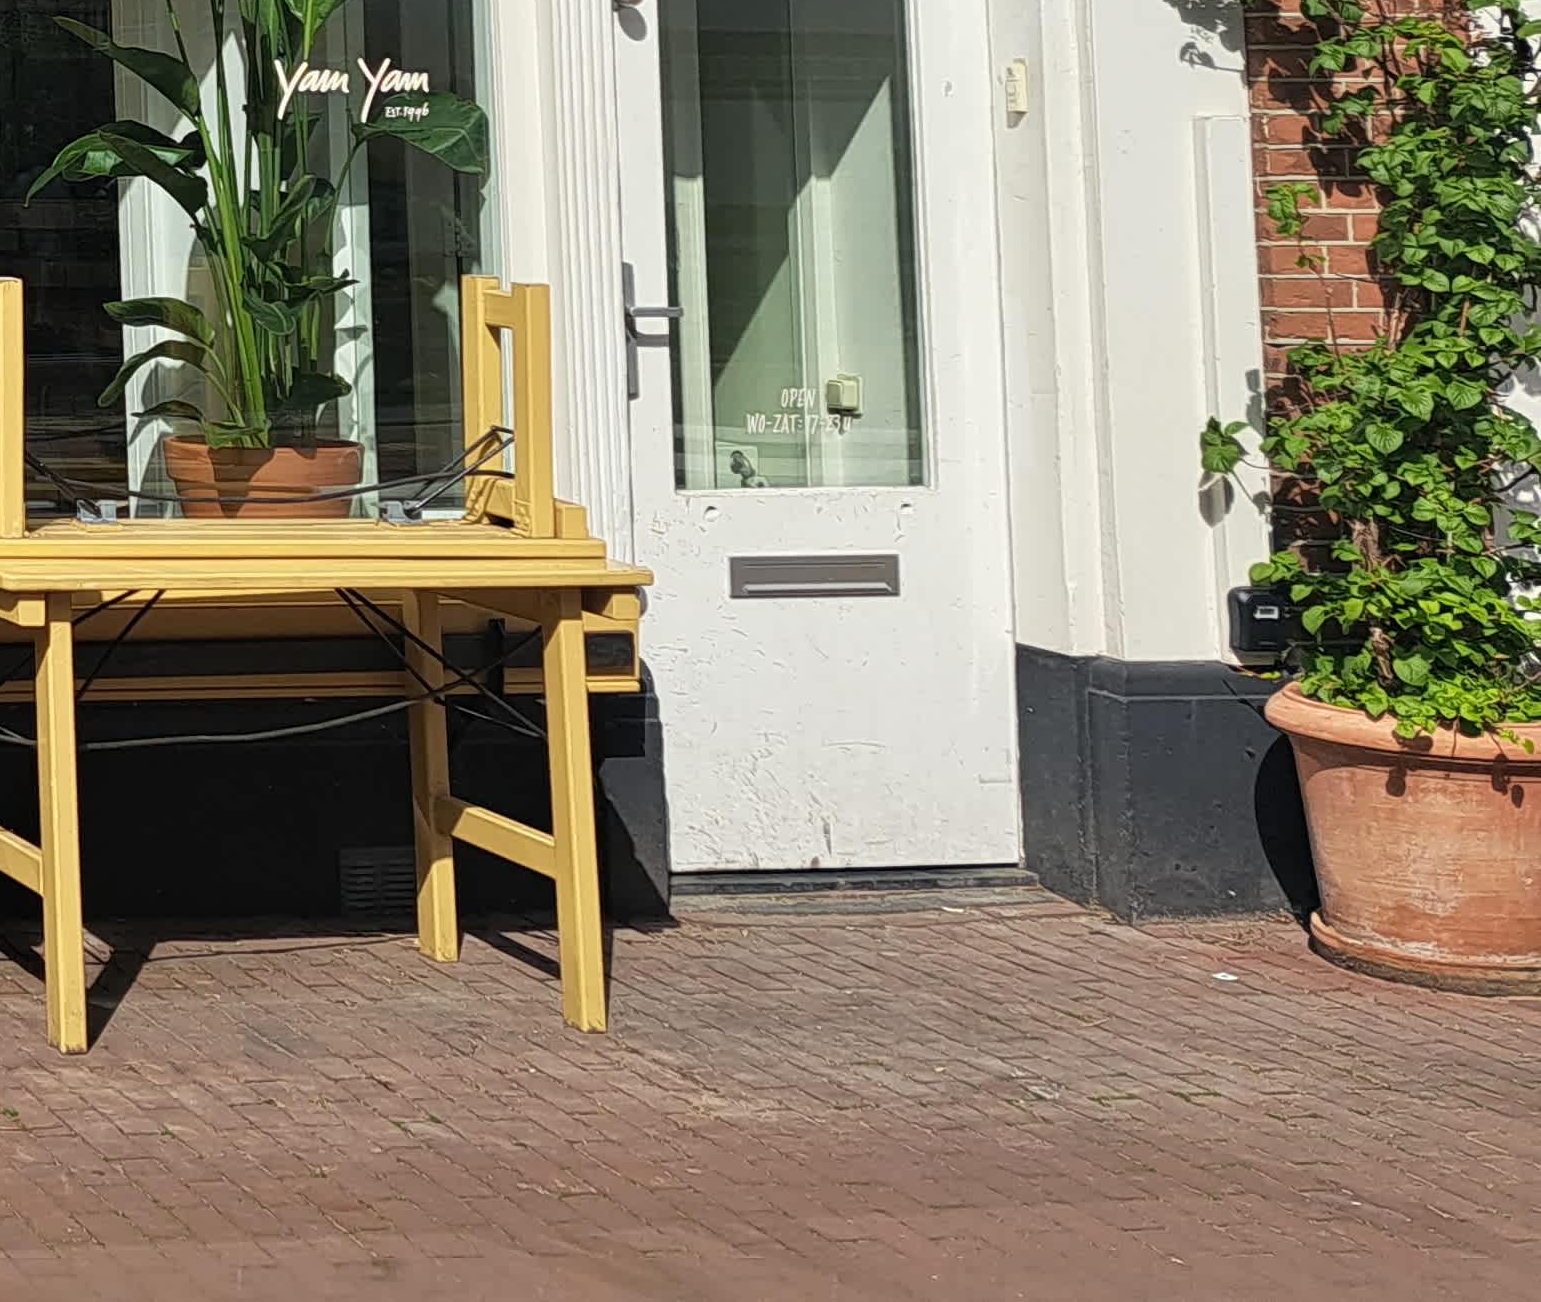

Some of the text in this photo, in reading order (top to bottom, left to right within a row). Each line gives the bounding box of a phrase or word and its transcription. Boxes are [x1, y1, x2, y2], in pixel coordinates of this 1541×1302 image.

[273, 57, 430, 123] Yam Yam
[780, 388, 816, 409] OPEN
